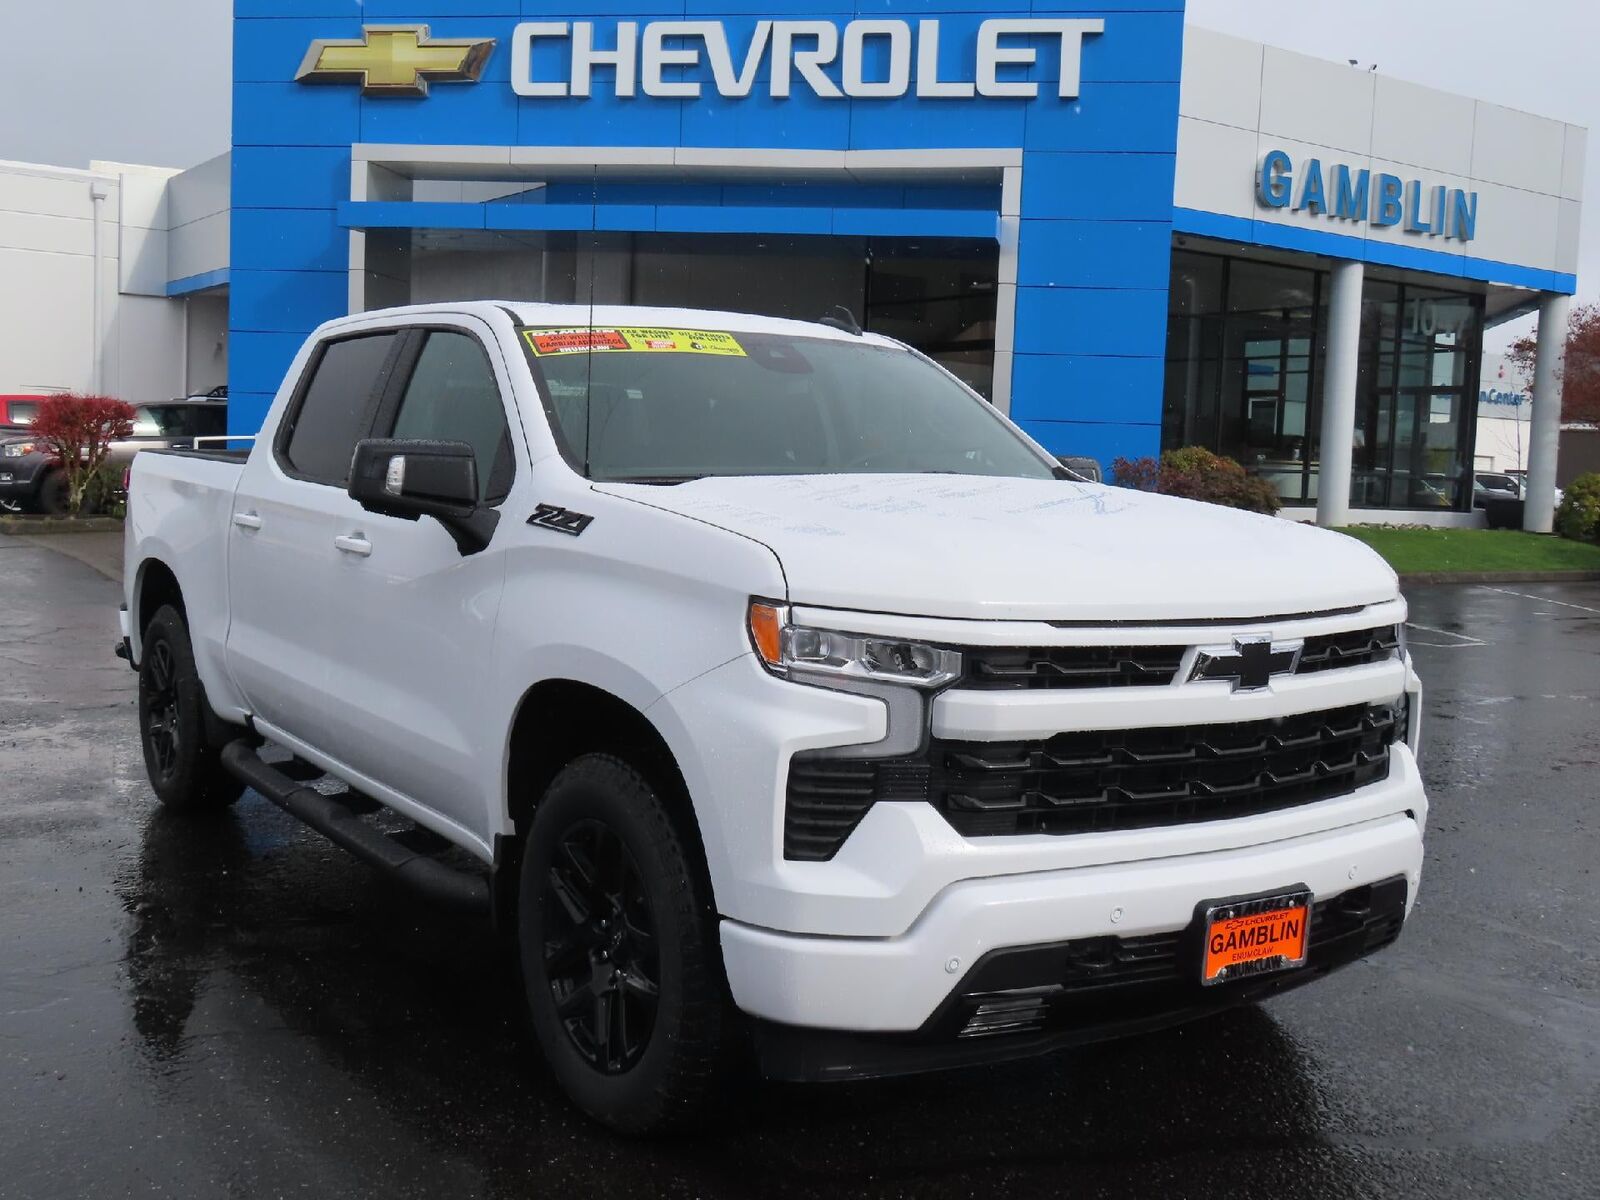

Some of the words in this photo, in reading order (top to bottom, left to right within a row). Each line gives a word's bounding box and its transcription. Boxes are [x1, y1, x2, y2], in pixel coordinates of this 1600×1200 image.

[510, 18, 1105, 99] CHEVROLET
[1256, 149, 1478, 242] GAMBLIN
[1488, 388, 1526, 405] Center
[1245, 912, 1289, 926] CHEVROLET
[1210, 919, 1299, 955] GAMBLIN
[1232, 946, 1274, 961] ENUMCLAW
